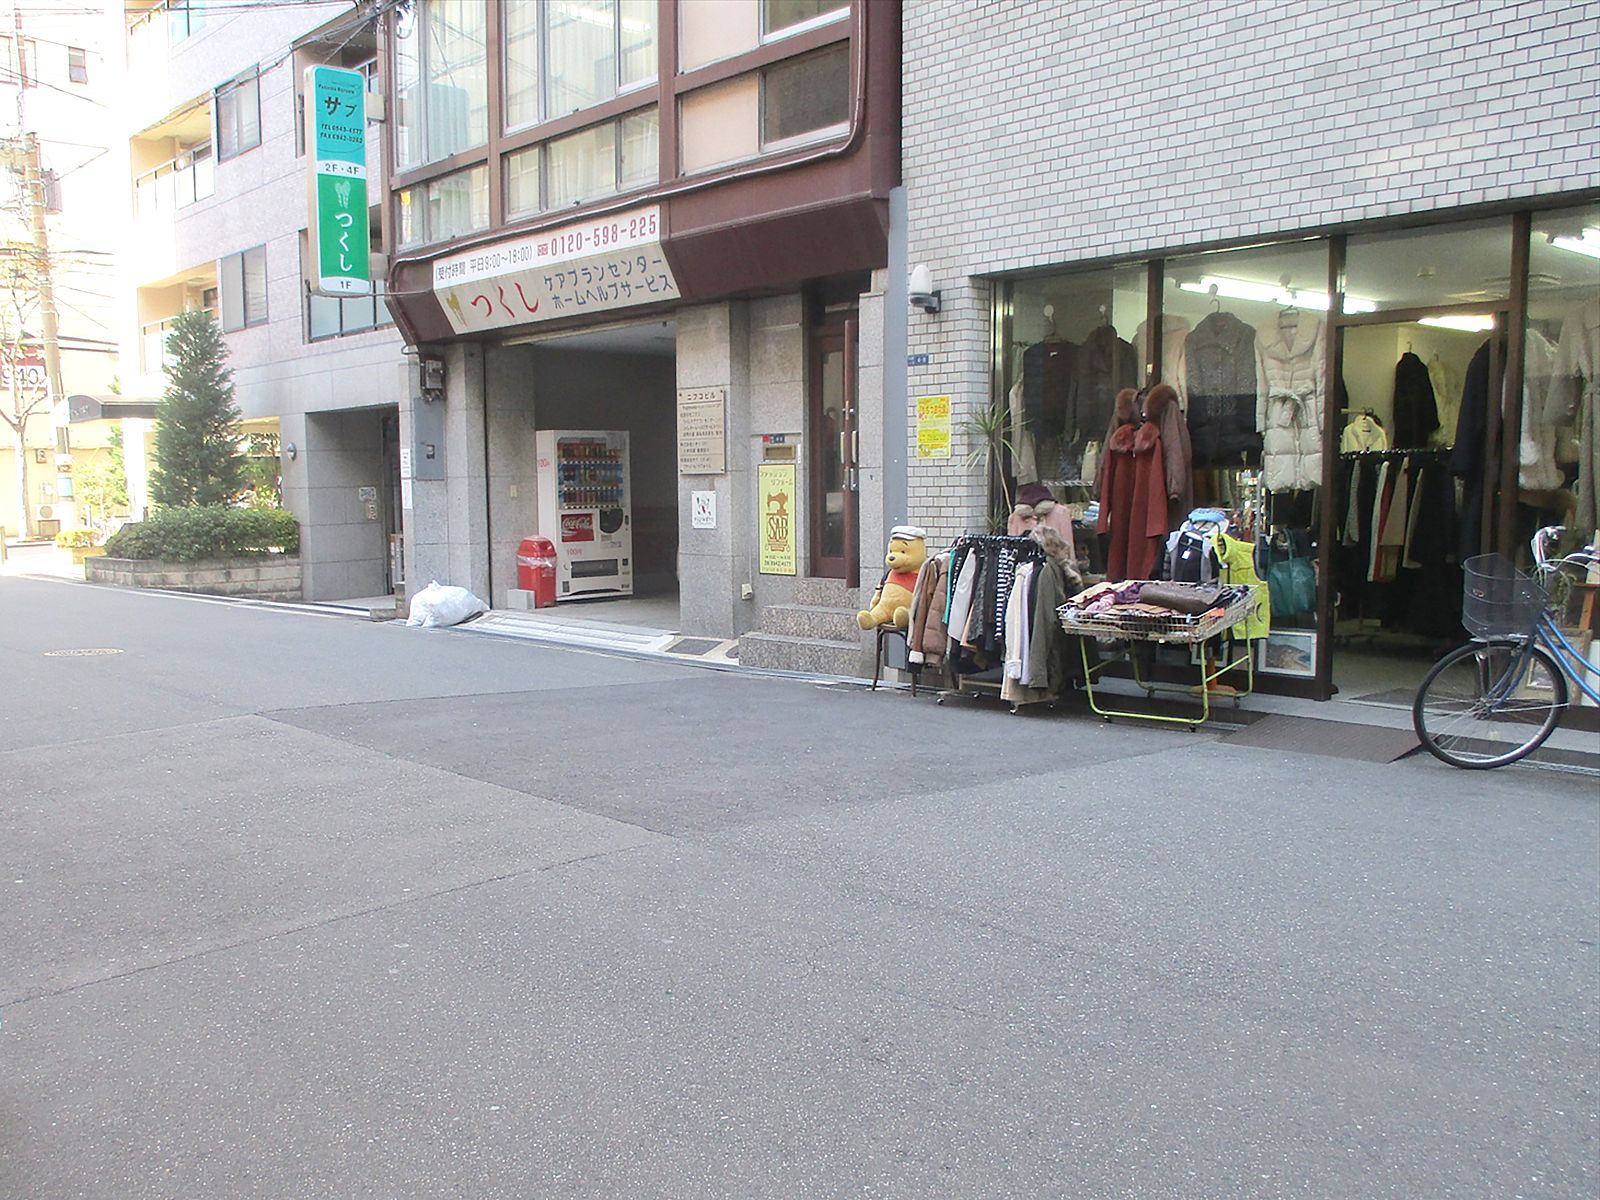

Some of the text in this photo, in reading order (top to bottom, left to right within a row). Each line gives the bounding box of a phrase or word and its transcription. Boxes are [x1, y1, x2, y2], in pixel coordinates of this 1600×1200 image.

[335, 212, 353, 272] つくし
[551, 214, 656, 256] 0120-598-225
[340, 281, 351, 289] 1F
[544, 256, 662, 291] ケアプランセンター
[471, 282, 539, 318] つくし
[552, 275, 673, 309] ホームヘルプサービス
